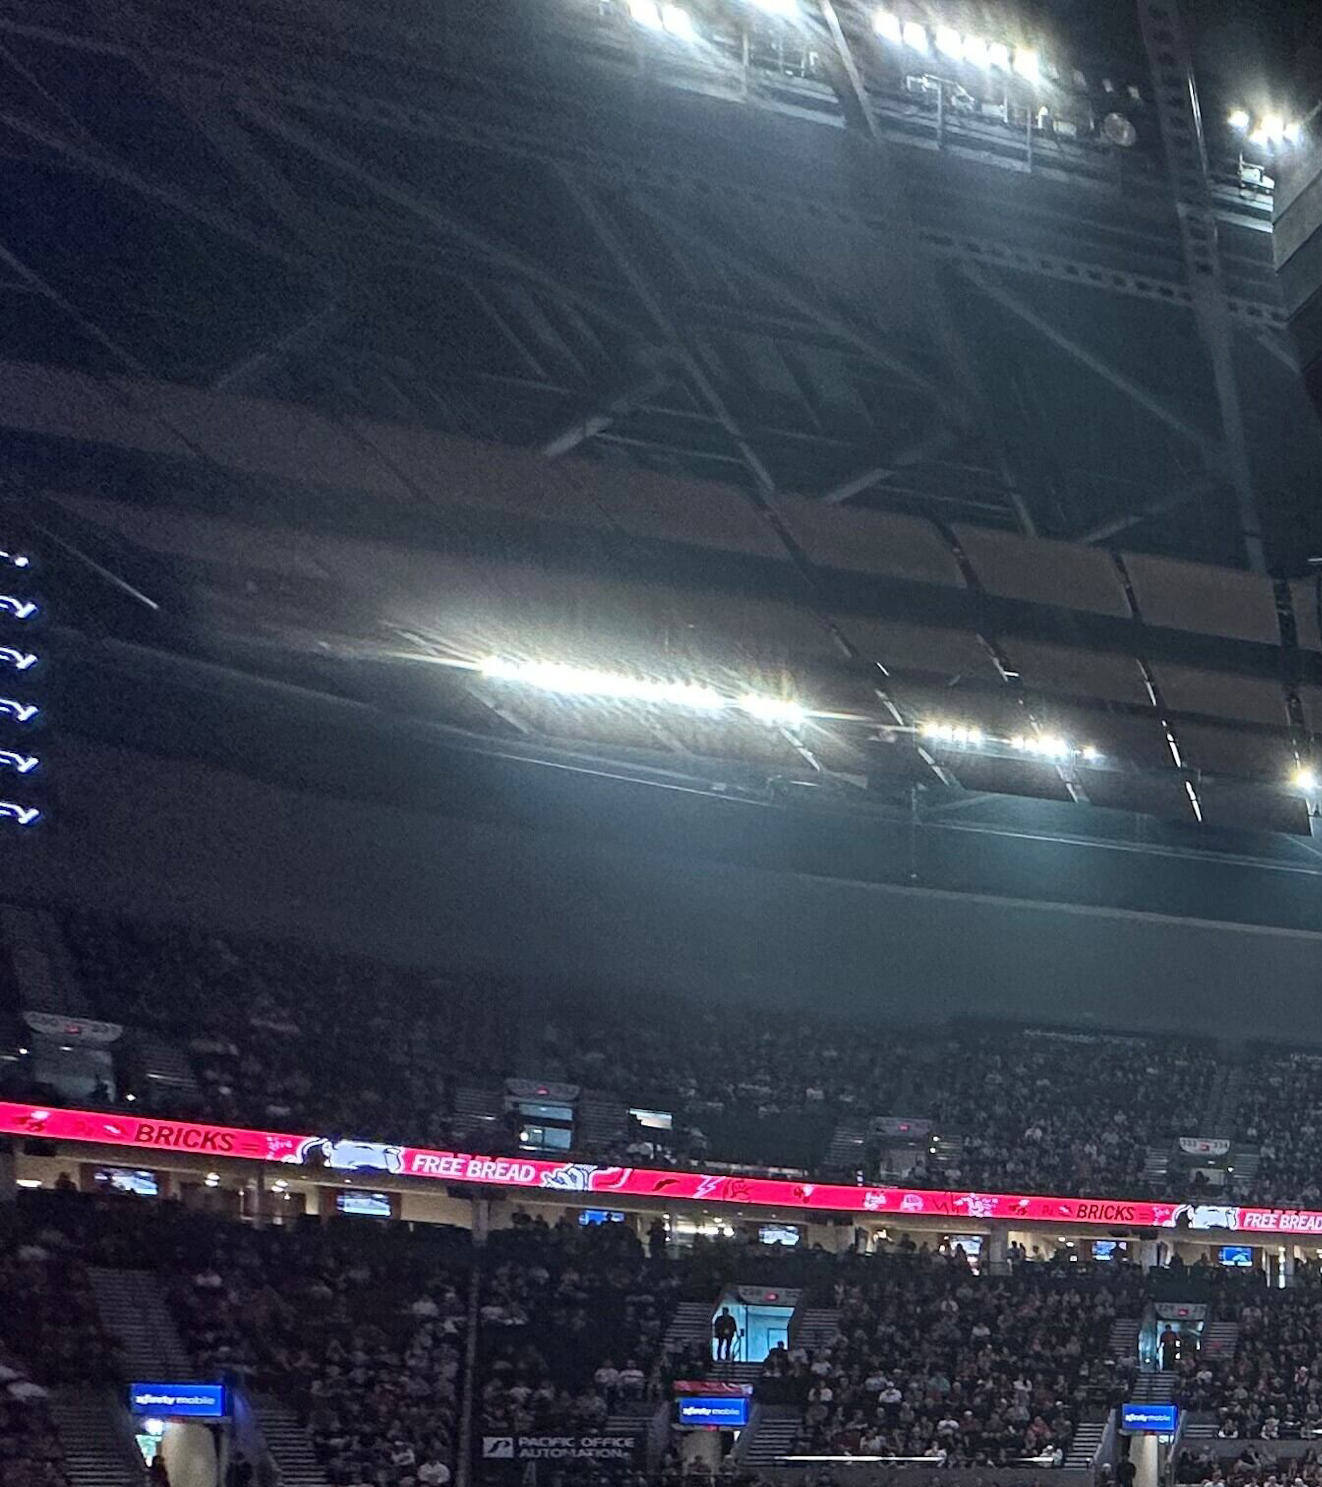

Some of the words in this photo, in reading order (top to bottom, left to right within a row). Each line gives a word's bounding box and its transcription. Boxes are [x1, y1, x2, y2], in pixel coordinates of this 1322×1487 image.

[134, 1124, 236, 1153] BRICKS
[410, 1153, 465, 1177] FREE
[466, 1159, 536, 1183] BREAD
[1075, 1202, 1135, 1222] BRICKS
[1243, 1211, 1278, 1230] FREE
[135, 1393, 175, 1407] xfinity
[176, 1394, 216, 1406] mobile
